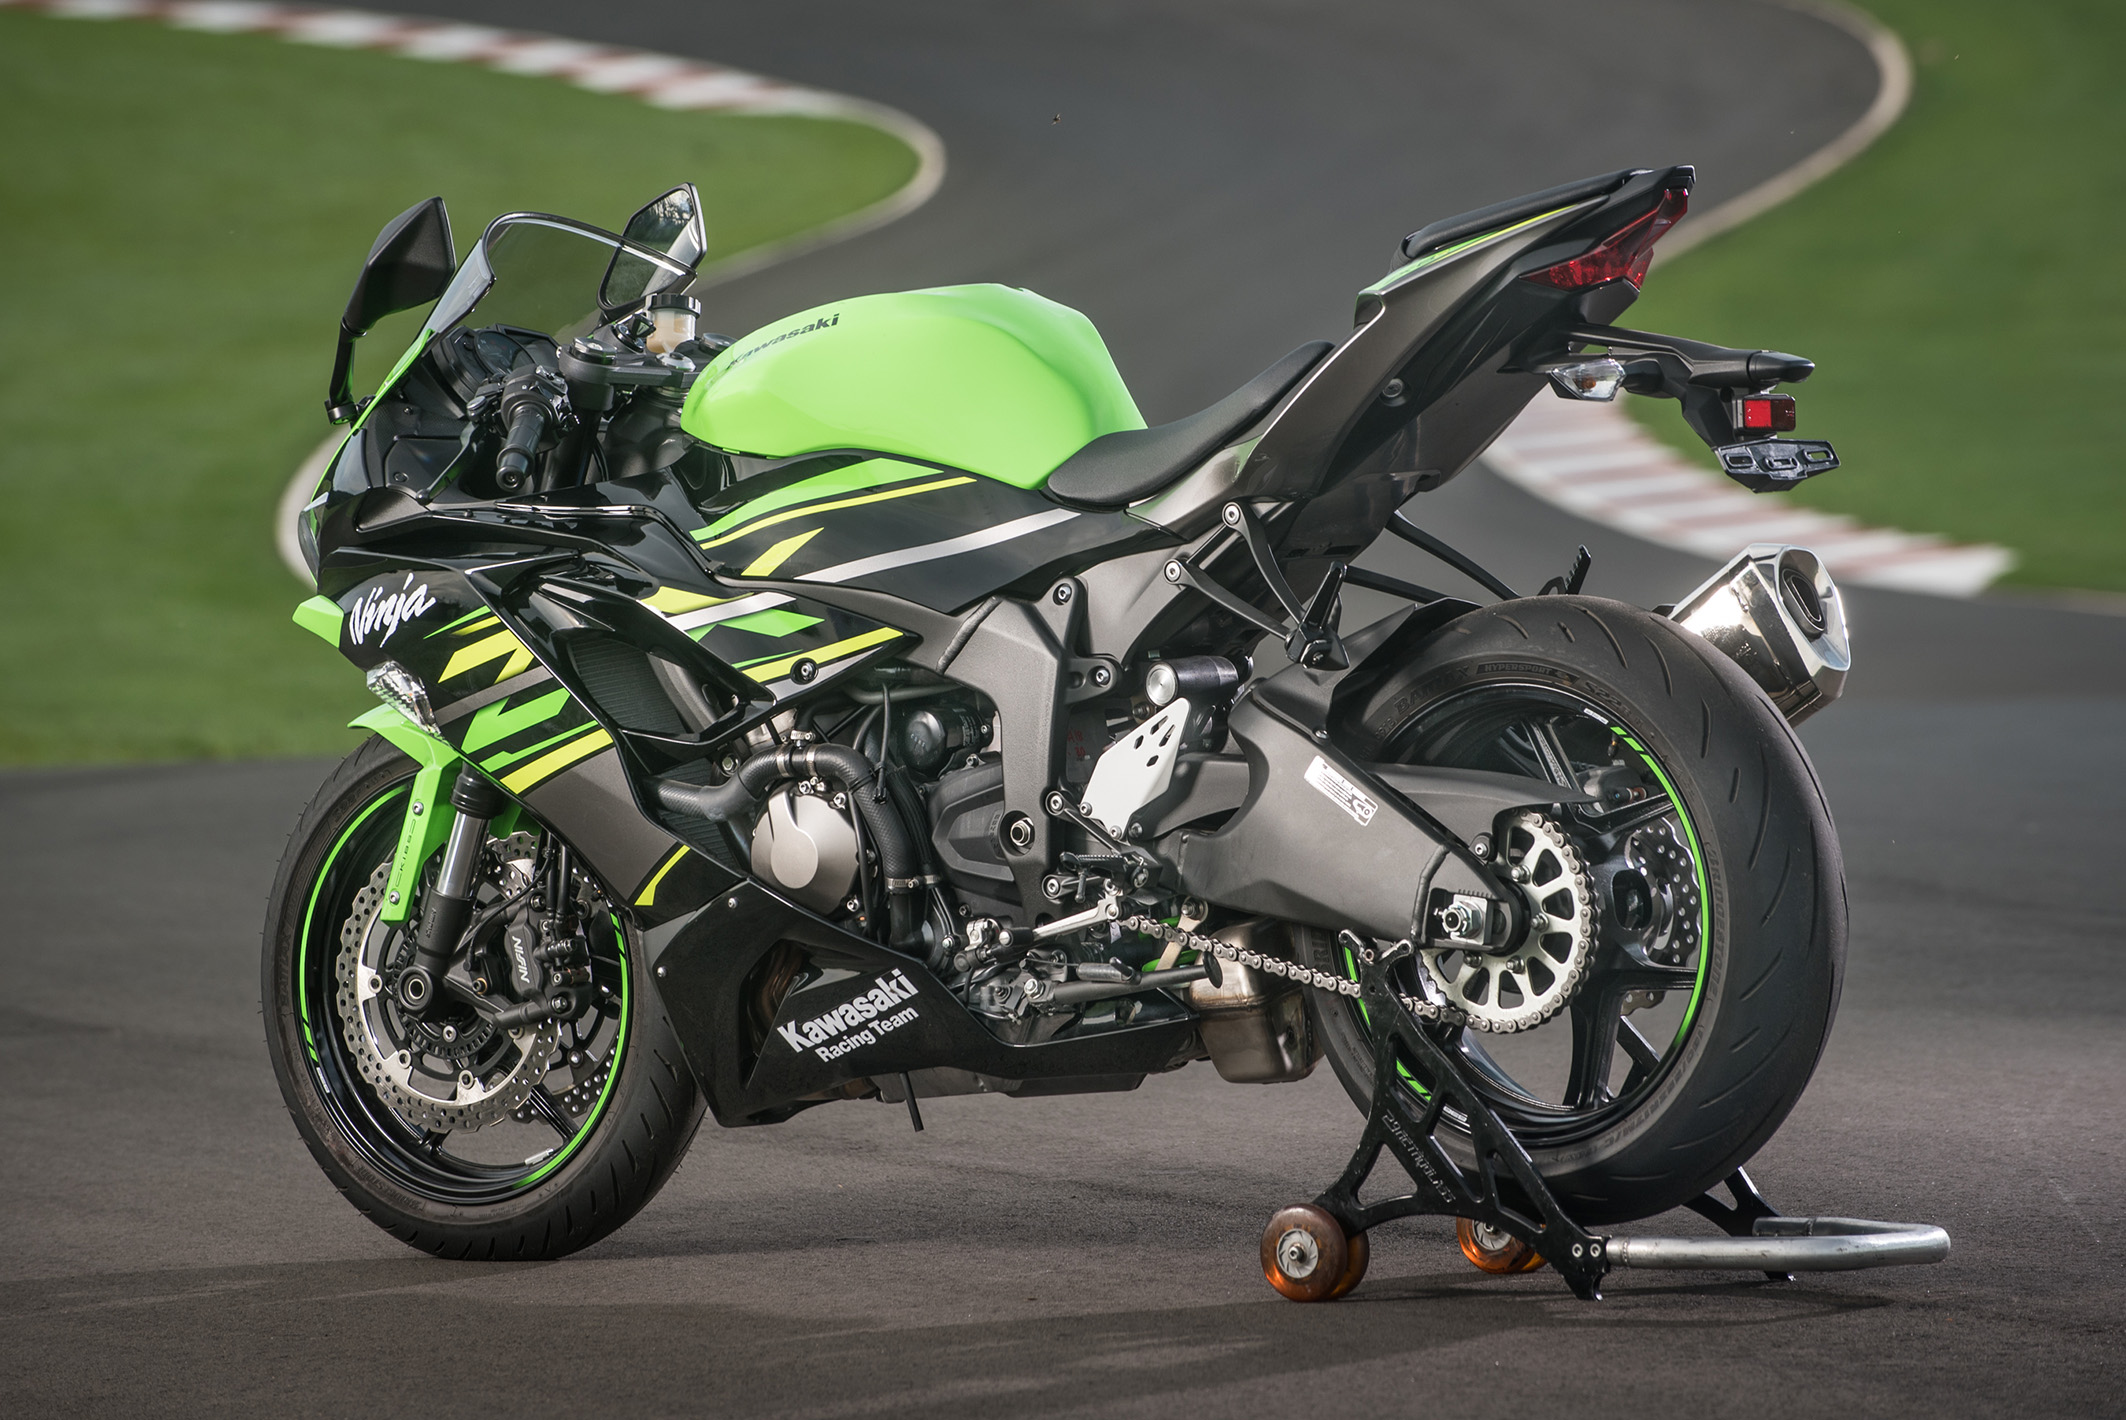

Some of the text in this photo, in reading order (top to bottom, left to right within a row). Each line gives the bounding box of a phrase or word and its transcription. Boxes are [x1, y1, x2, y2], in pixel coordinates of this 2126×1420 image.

[726, 313, 840, 370] Kawasaki
[349, 572, 436, 648] Ninja
[1484, 663, 1553, 675] HYPERSPORT
[511, 935, 531, 984] NISSIN
[776, 967, 919, 1054] Kawasaki
[814, 1006, 920, 1063] Racing Team
